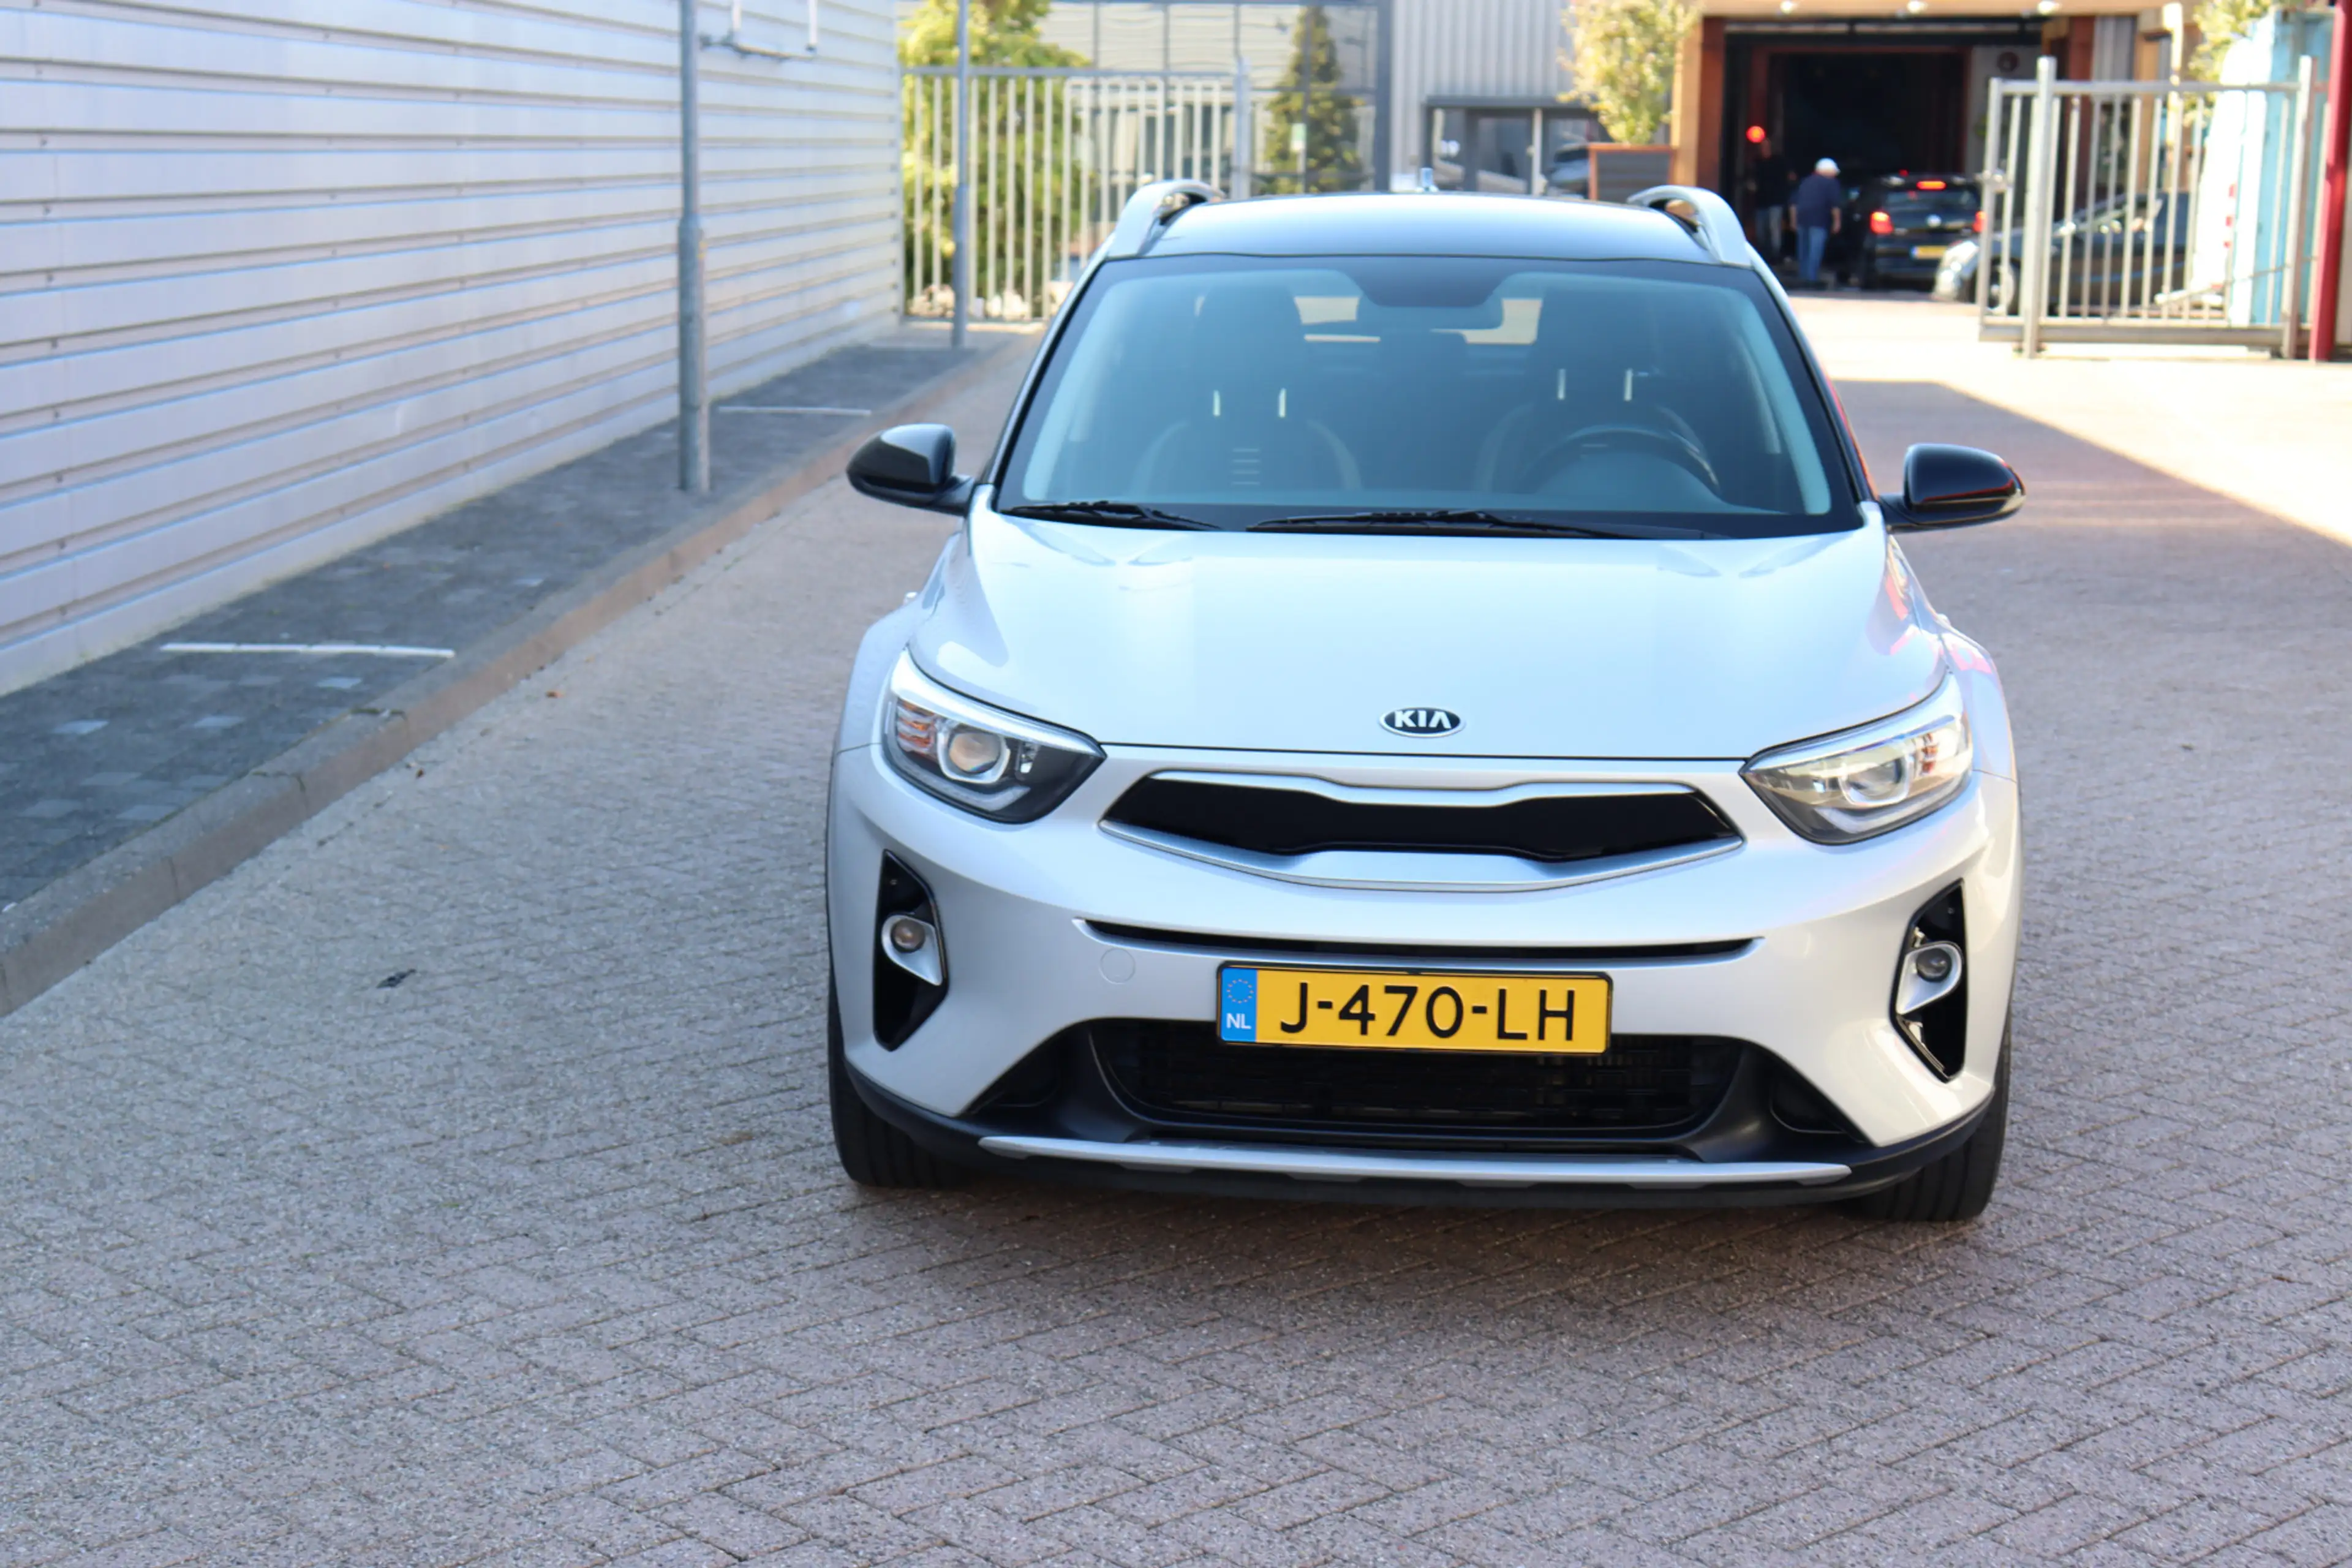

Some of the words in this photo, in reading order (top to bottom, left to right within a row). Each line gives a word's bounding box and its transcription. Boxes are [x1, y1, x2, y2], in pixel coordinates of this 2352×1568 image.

[1394, 709, 1452, 729] KIA
[1226, 1012, 1252, 1030] NL
[1280, 982, 1575, 1041] J-470-LH
